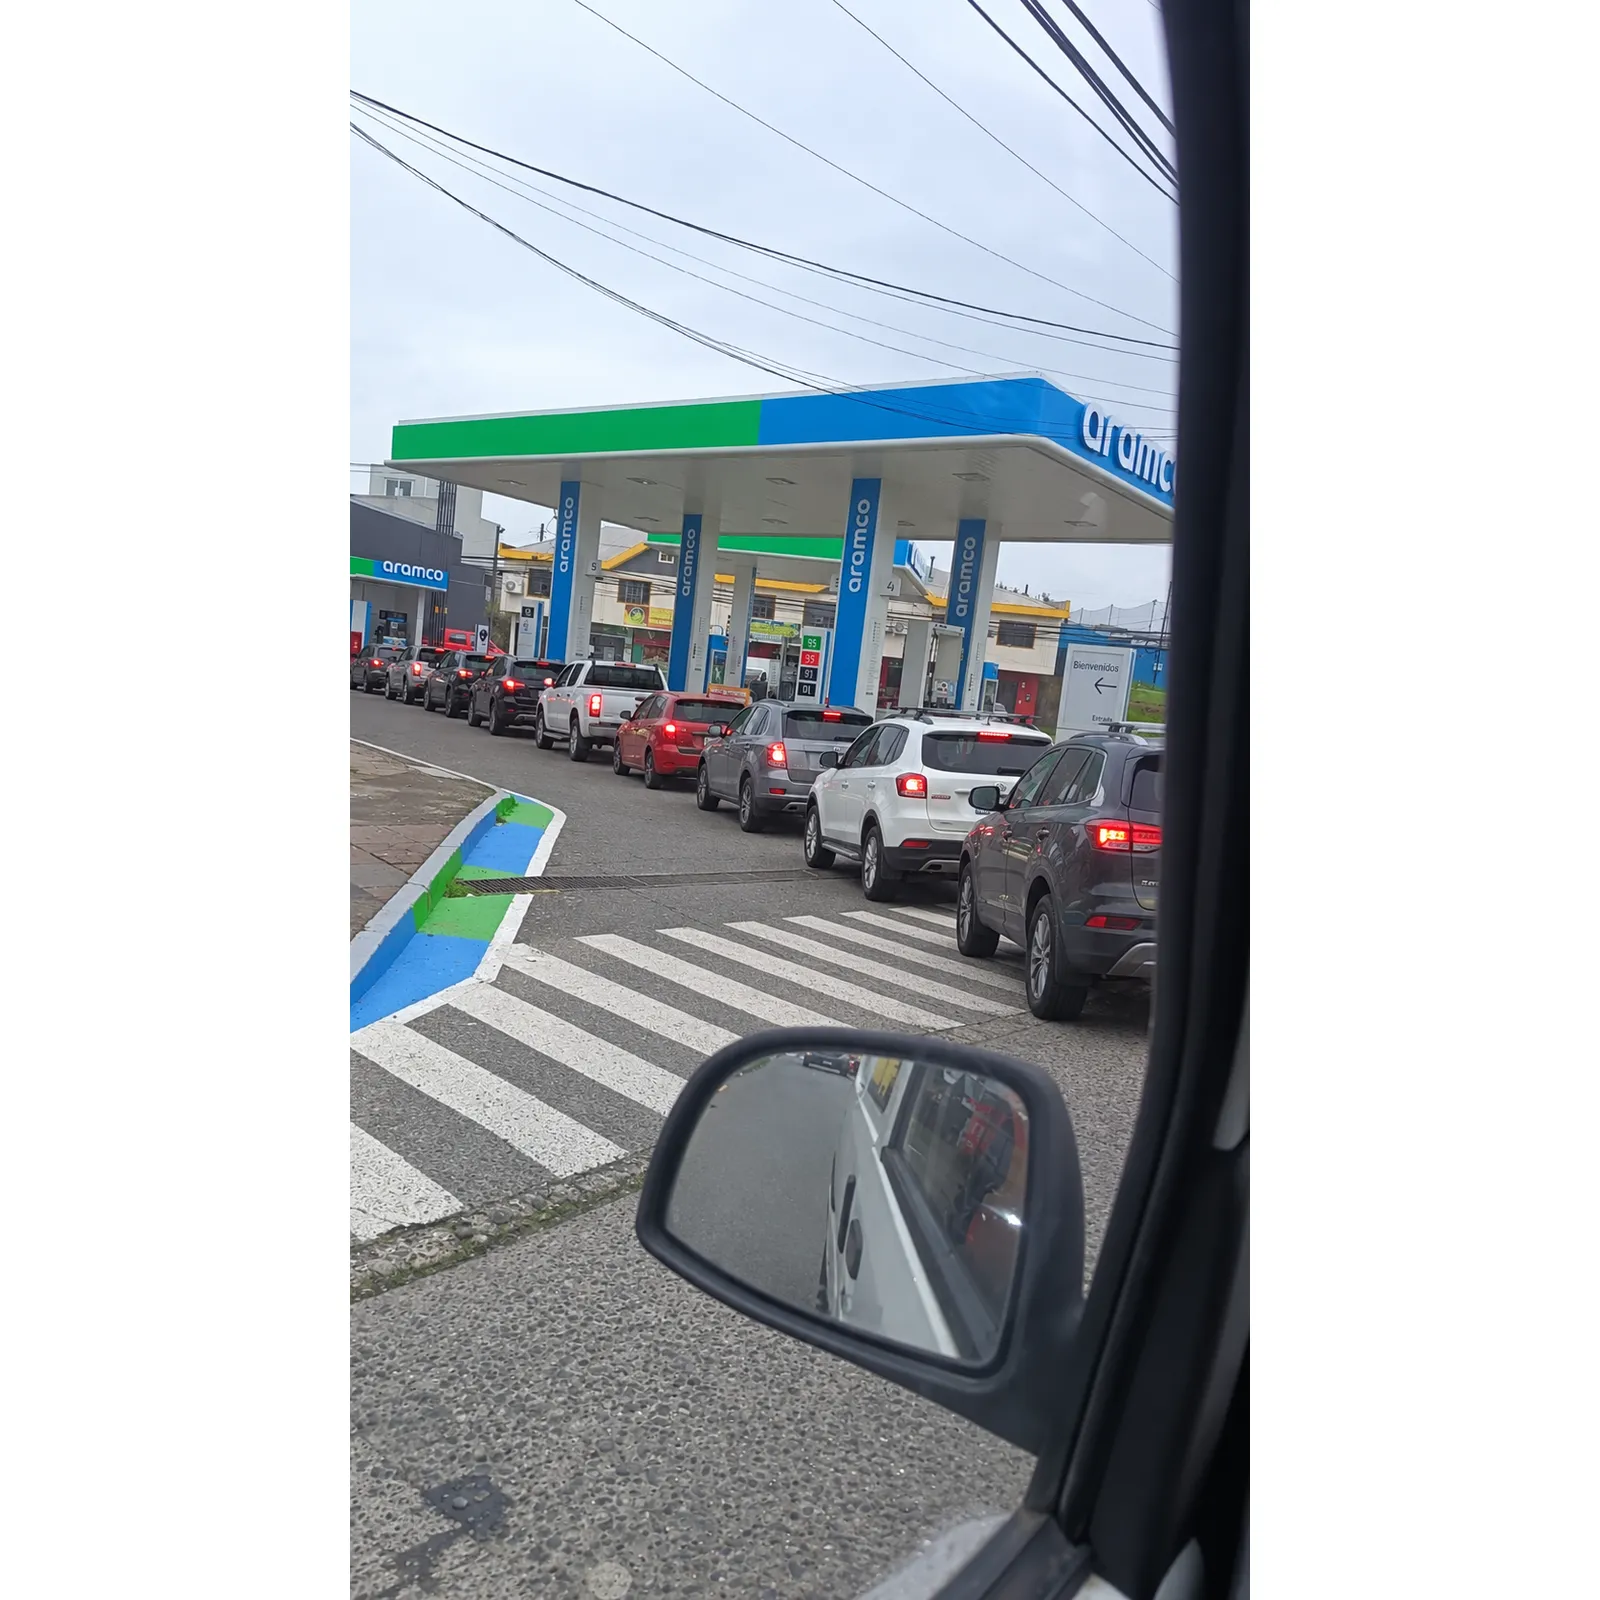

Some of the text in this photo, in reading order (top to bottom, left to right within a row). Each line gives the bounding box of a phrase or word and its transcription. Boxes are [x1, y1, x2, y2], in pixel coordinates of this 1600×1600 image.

[1082, 402, 1176, 493] aramc
[559, 497, 574, 573] aramco
[681, 528, 696, 596] aramco
[848, 499, 871, 593] aramco
[382, 560, 444, 582] aramco
[886, 581, 895, 592] 4
[955, 536, 976, 617] aramco
[1073, 660, 1120, 673] Bienvenidos
[1091, 714, 1113, 723] Entrada
